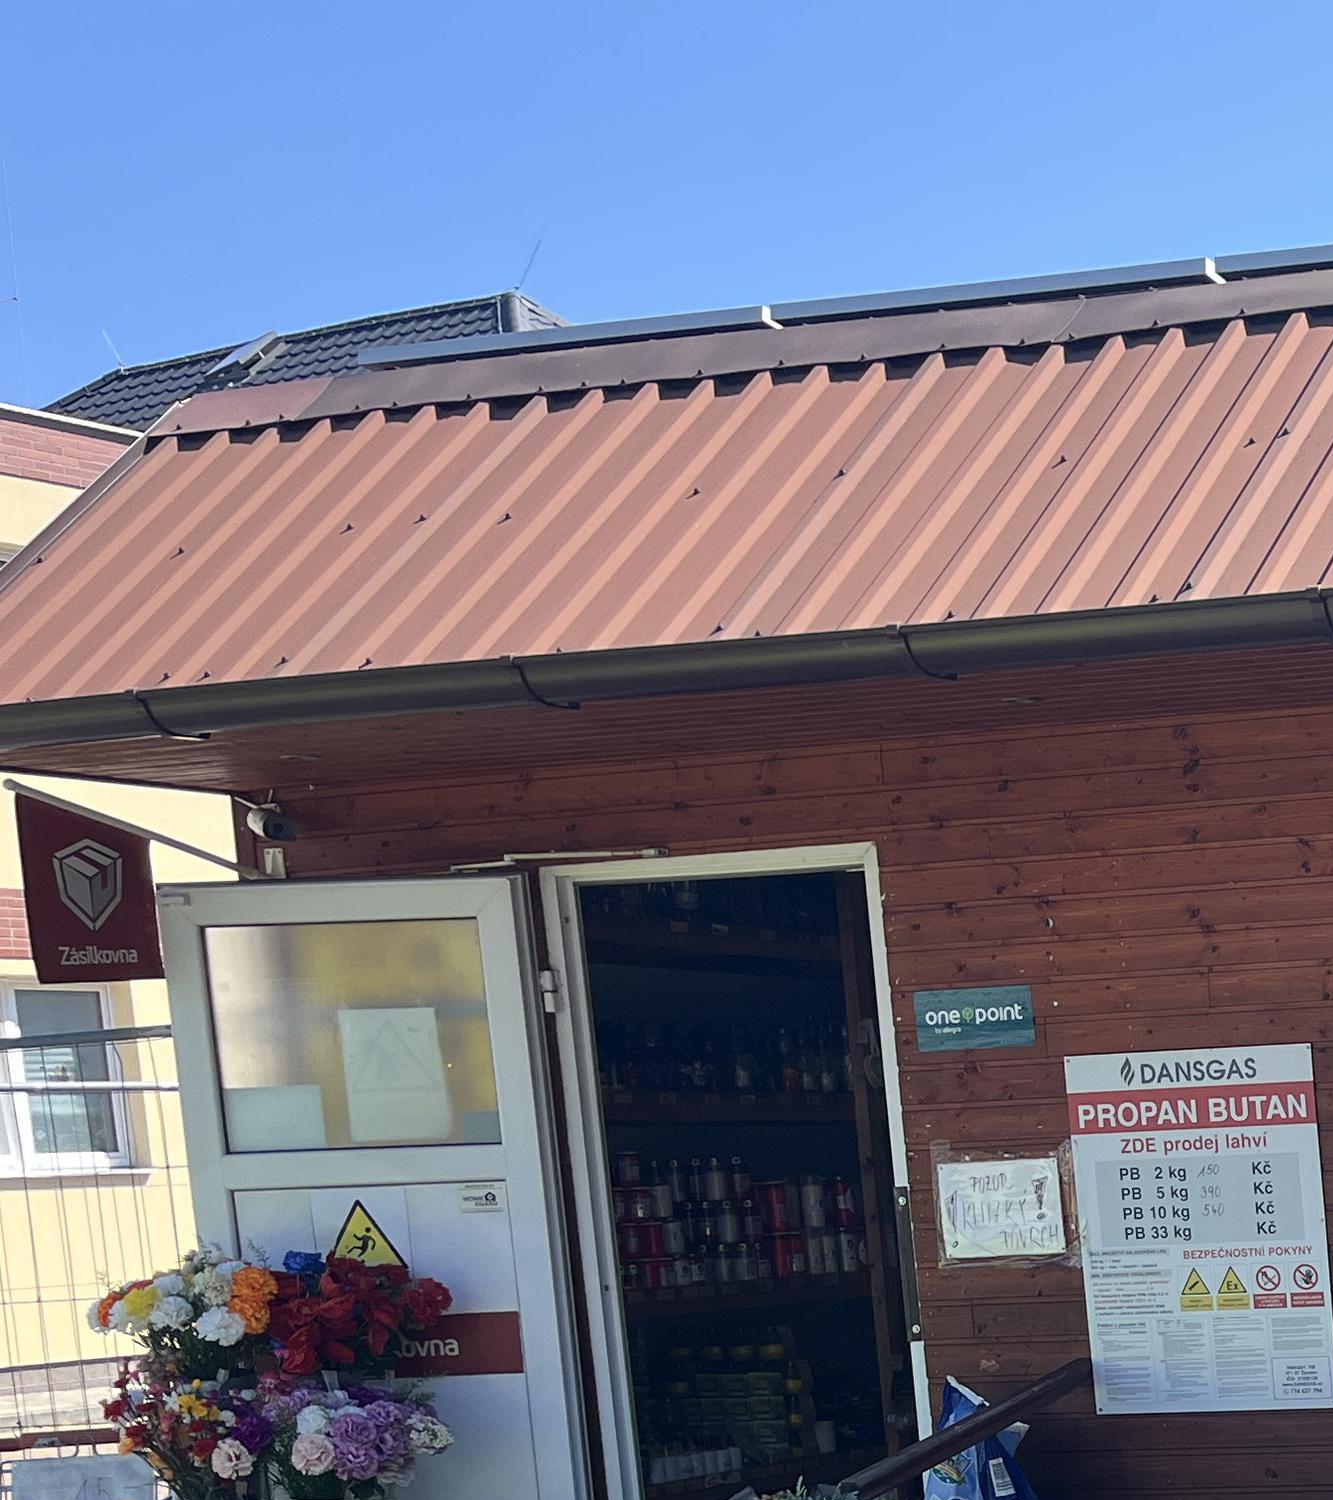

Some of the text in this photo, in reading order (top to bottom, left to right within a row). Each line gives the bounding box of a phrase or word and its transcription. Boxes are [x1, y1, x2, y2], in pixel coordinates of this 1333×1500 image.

[58, 945, 138, 966] Zásilkovna
[925, 1003, 1024, 1025] one point
[1140, 1057, 1257, 1084] DANSGAS
[1077, 1093, 1308, 1129] PROPAN BUTAN
[1120, 1131, 1269, 1156] ZDE prodej lahví
[1119, 1167, 1141, 1181] PB
[1154, 1166, 1163, 1180] 2
[1168, 1165, 1187, 1182] kg
[1251, 1161, 1272, 1175] Kč
[1121, 1187, 1142, 1201] PB
[1156, 1186, 1165, 1199] 5
[1170, 1185, 1189, 1201] kg
[1253, 1181, 1274, 1195] Kč
[1123, 1207, 1144, 1220] PB
[1149, 1206, 1167, 1219] 10
[1172, 1205, 1190, 1221] kg
[1255, 1201, 1276, 1215] Kč
[1125, 1221, 1277, 1241] PB 33 kg Kč
[1183, 1245, 1313, 1260] BEZPEČNOSTNÍ POKYNY
